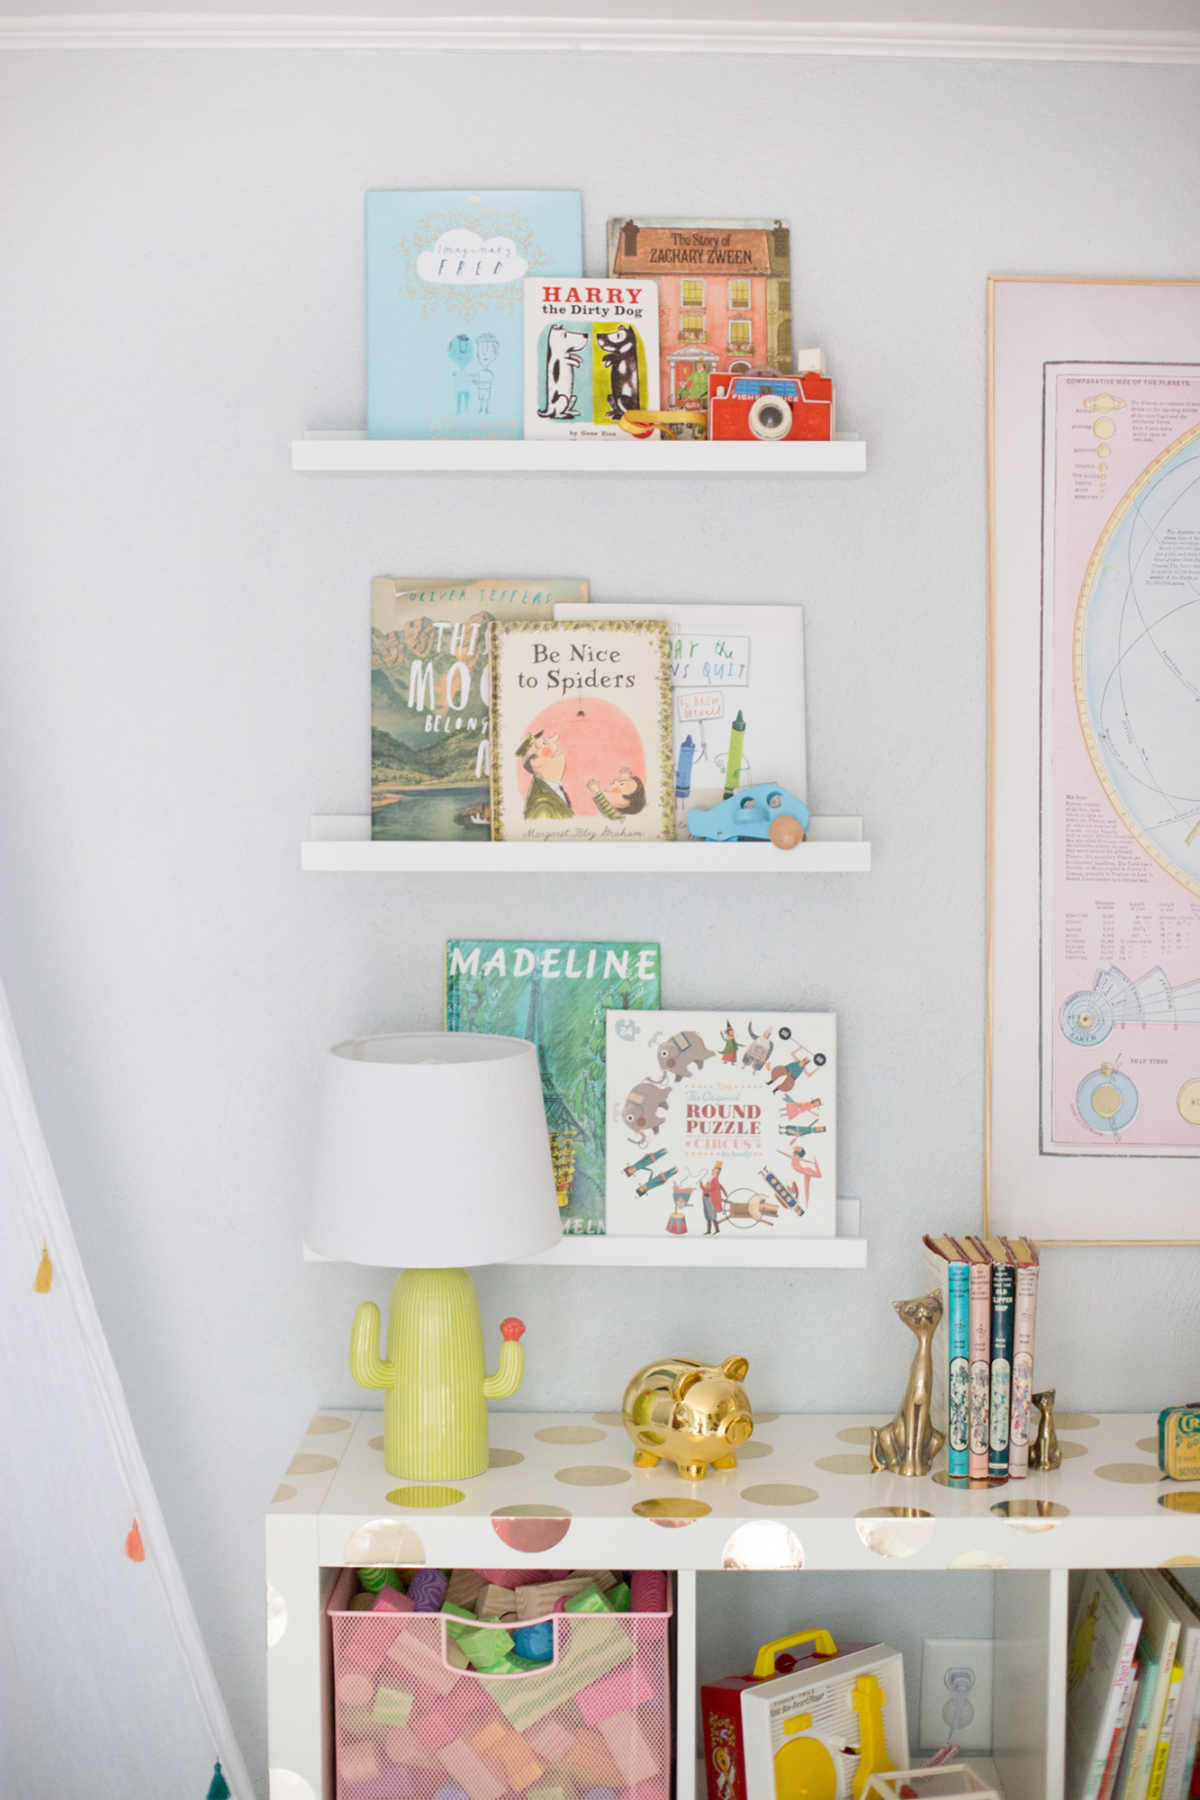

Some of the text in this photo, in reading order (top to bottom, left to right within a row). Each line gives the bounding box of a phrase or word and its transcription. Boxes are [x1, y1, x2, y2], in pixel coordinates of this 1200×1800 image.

[672, 232, 731, 250] The Story of
[649, 248, 752, 265] ZACHARY ZWEEN
[542, 285, 643, 304] HARRY
[542, 304, 643, 318] the Dirty Dog
[532, 642, 621, 664] Be Nice
[518, 667, 636, 696] to Spiders
[703, 660, 746, 685] QUIT
[424, 713, 489, 734] BELONG
[450, 947, 657, 980] MADELINE
[687, 1103, 761, 1119] ROUND
[687, 1120, 761, 1134] PUZZLE
